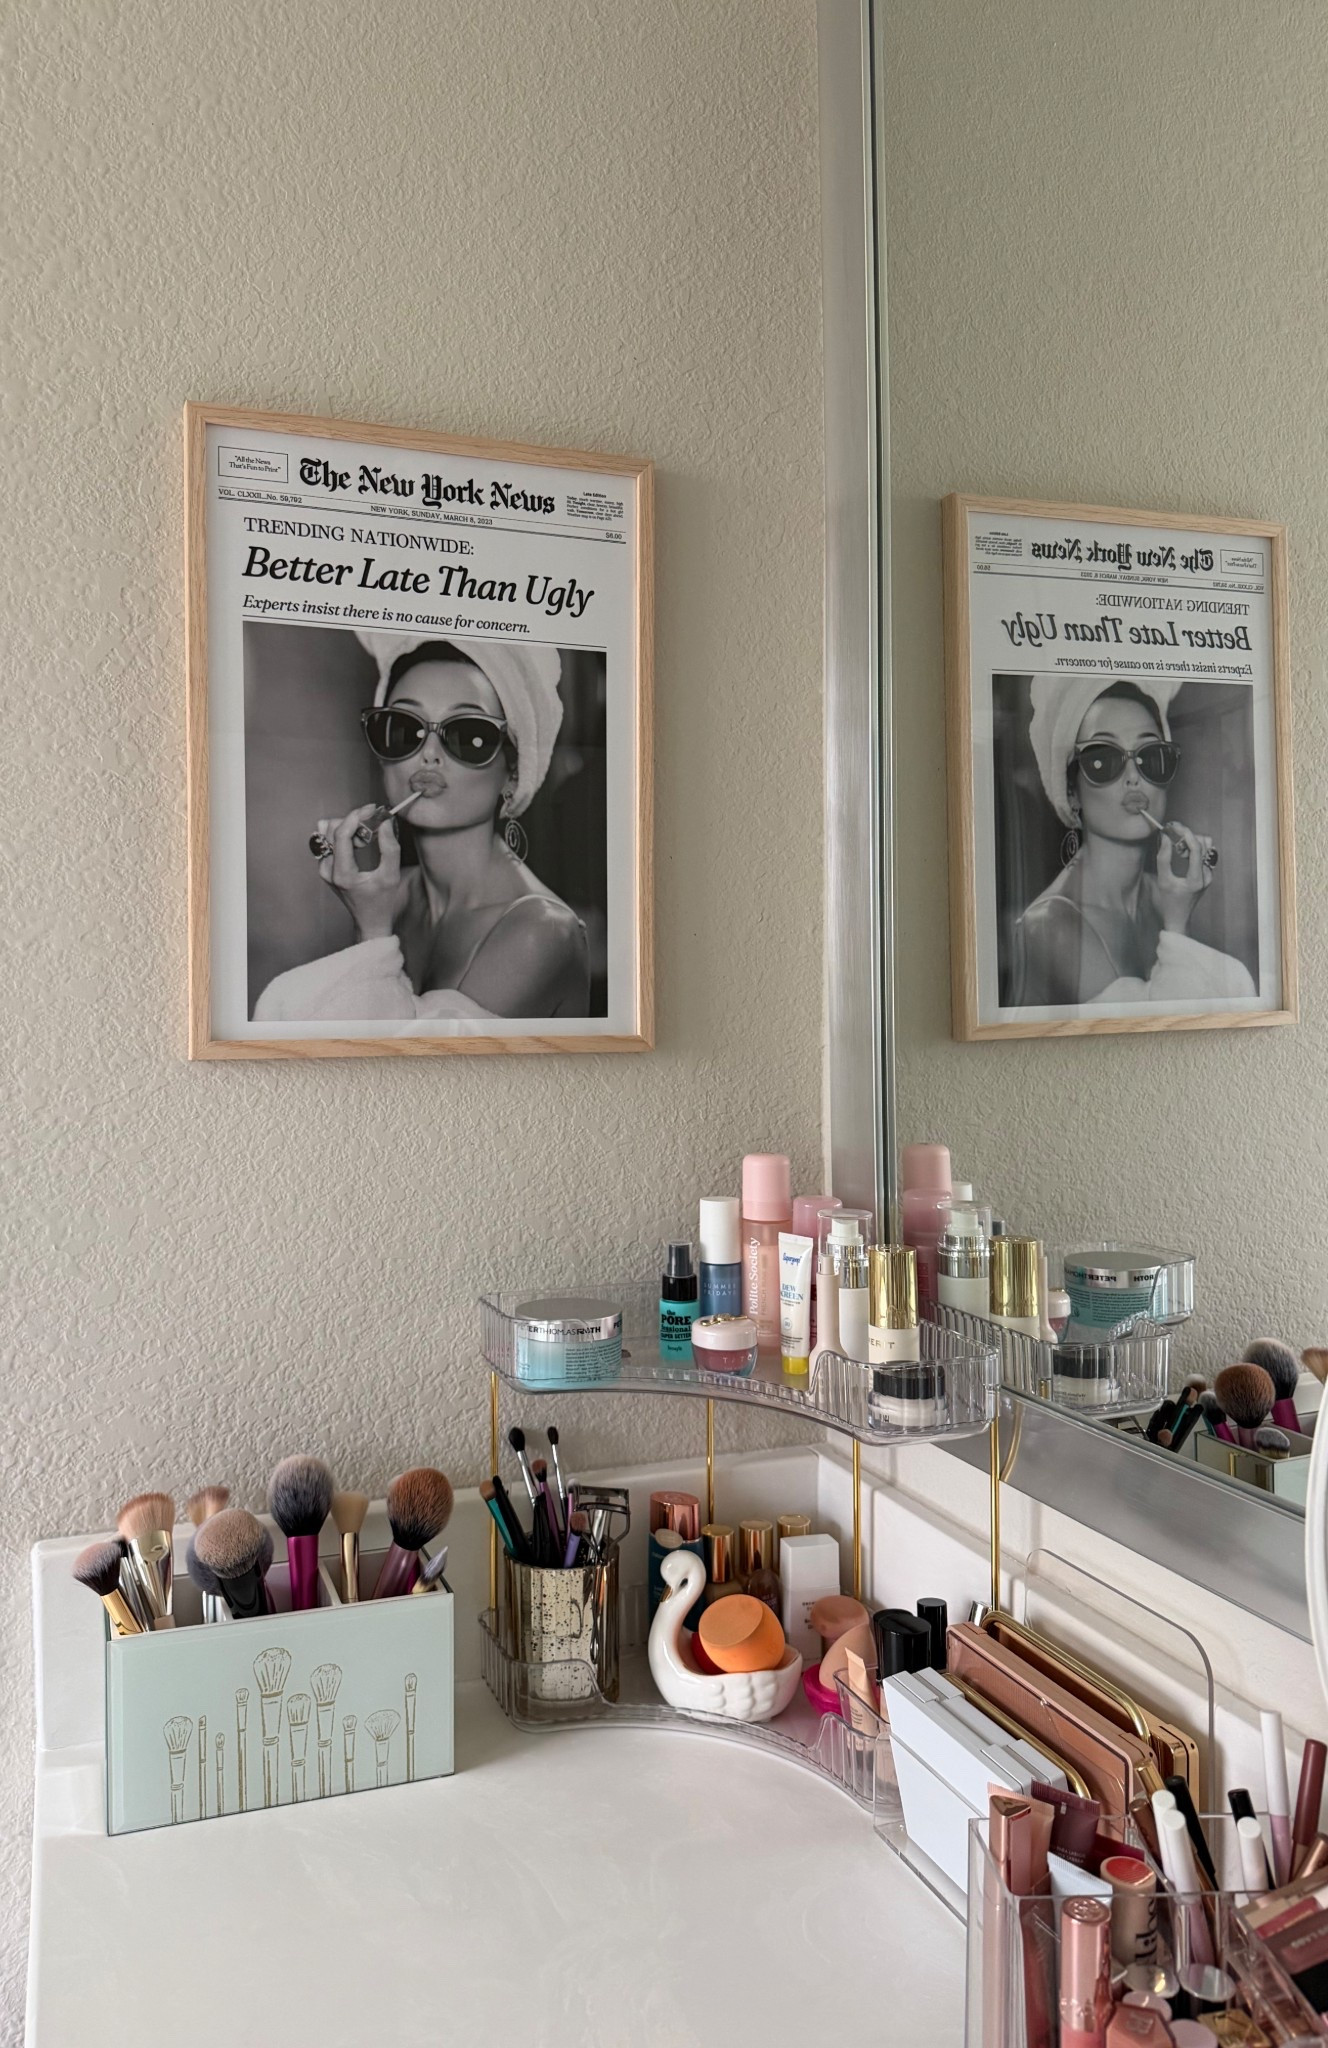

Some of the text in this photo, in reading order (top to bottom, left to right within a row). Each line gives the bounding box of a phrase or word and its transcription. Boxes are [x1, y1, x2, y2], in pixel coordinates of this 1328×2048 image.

[218, 488, 235, 496] VOL.
[300, 458, 555, 515] The New York News
[371, 505, 387, 513] NEW
[388, 507, 410, 516] YORK,
[412, 509, 442, 520] SUNDAY,
[444, 514, 468, 522] MARCH
[244, 517, 474, 555] TRENDING NATIONWIDE:
[242, 546, 595, 618] Better Late Than Ugly
[242, 594, 530, 633] Experts insist there is no cause for concern.
[749, 1237, 760, 1315] Polite Society
[782, 1283, 796, 1292] DEW
[661, 1315, 691, 1325] PORE
